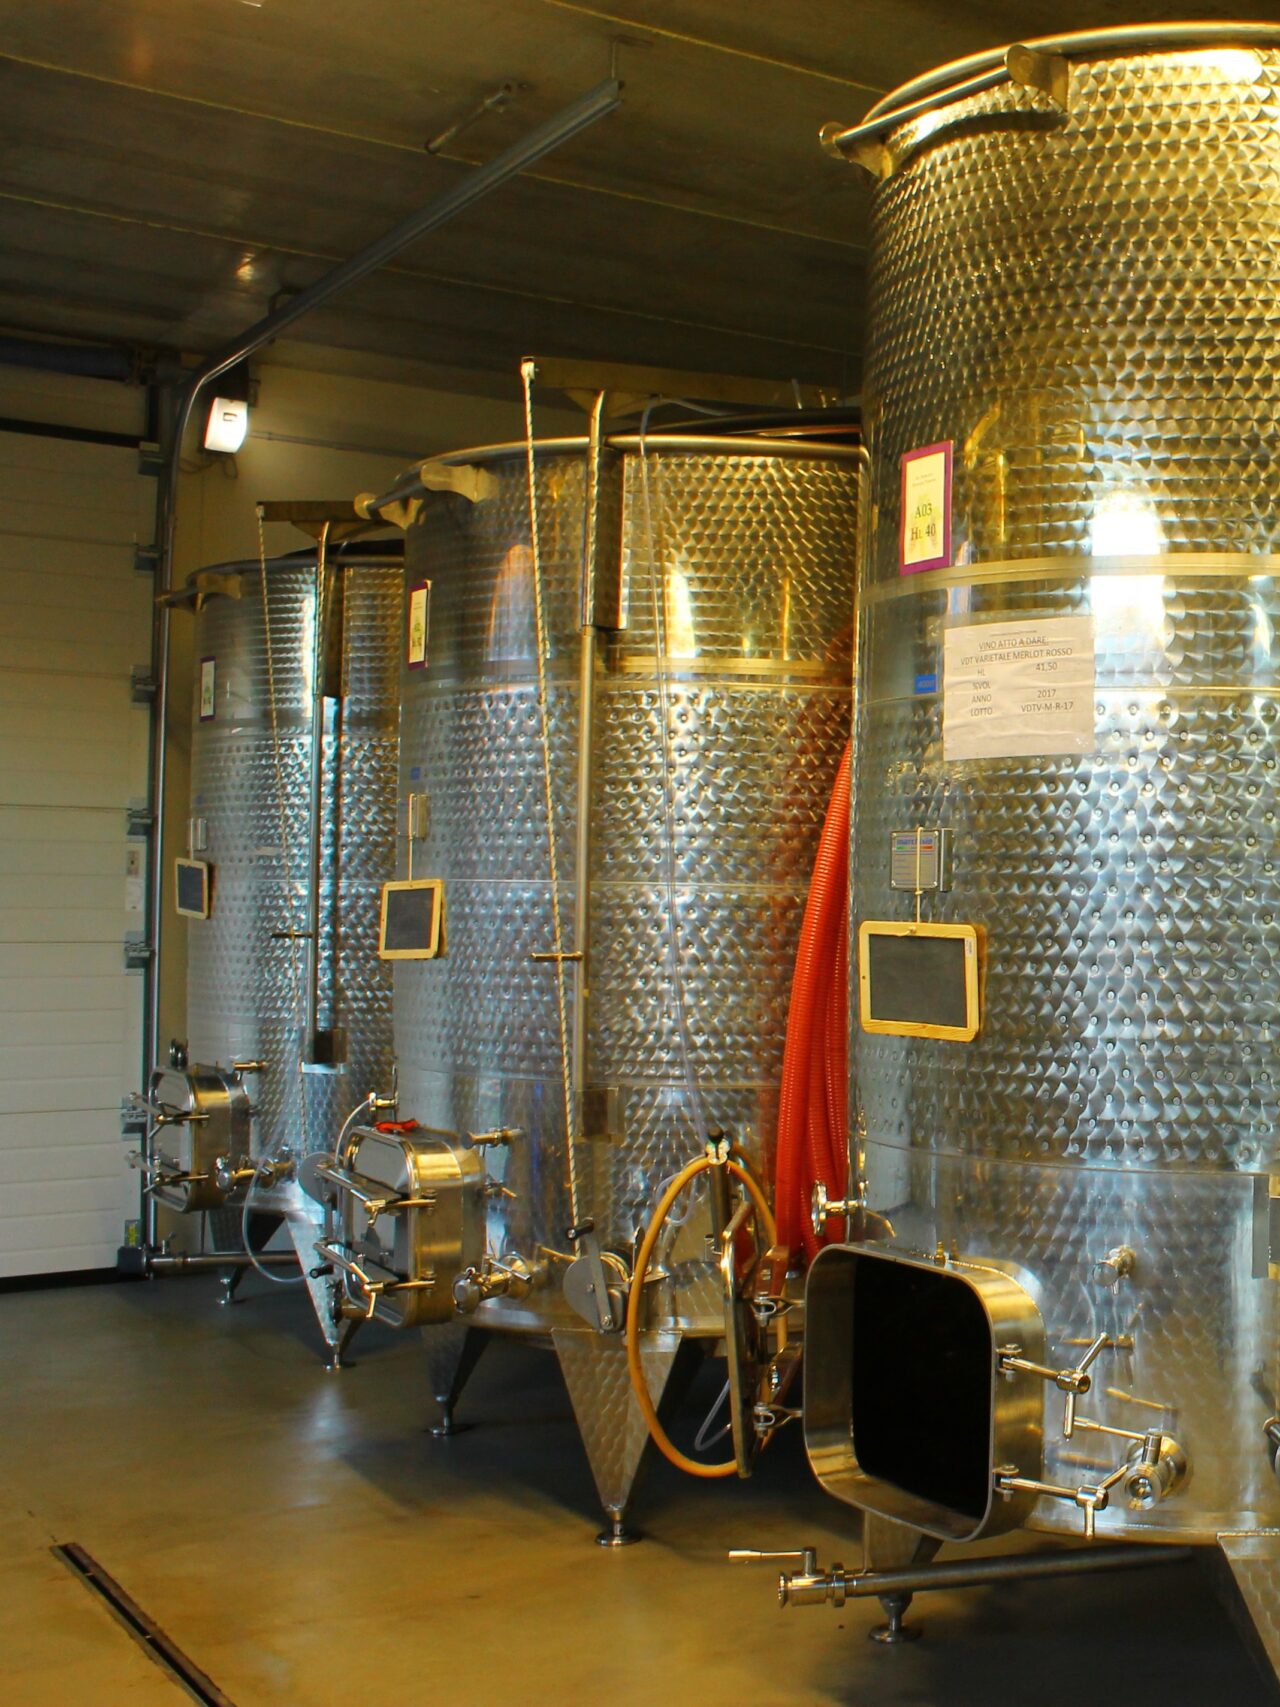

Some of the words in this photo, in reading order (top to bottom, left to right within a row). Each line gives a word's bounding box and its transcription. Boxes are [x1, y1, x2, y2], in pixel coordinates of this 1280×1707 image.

[915, 503, 933, 518] A03
[925, 523, 936, 537] 40
[978, 640, 996, 650] VINO
[998, 639, 1017, 649] ATTO
[1018, 638, 1025, 646] A
[961, 656, 974, 665] VDT
[975, 652, 1011, 663] VARIETALE
[1013, 649, 1043, 660] MERLOT
[1047, 647, 1073, 657] ROSSO
[1035, 663, 1058, 672] 41,50
[971, 694, 992, 703] ANNO
[1037, 689, 1056, 699] 2017
[970, 707, 993, 717] LOTTO
[1021, 701, 1074, 713] VDTV-M-R-17
